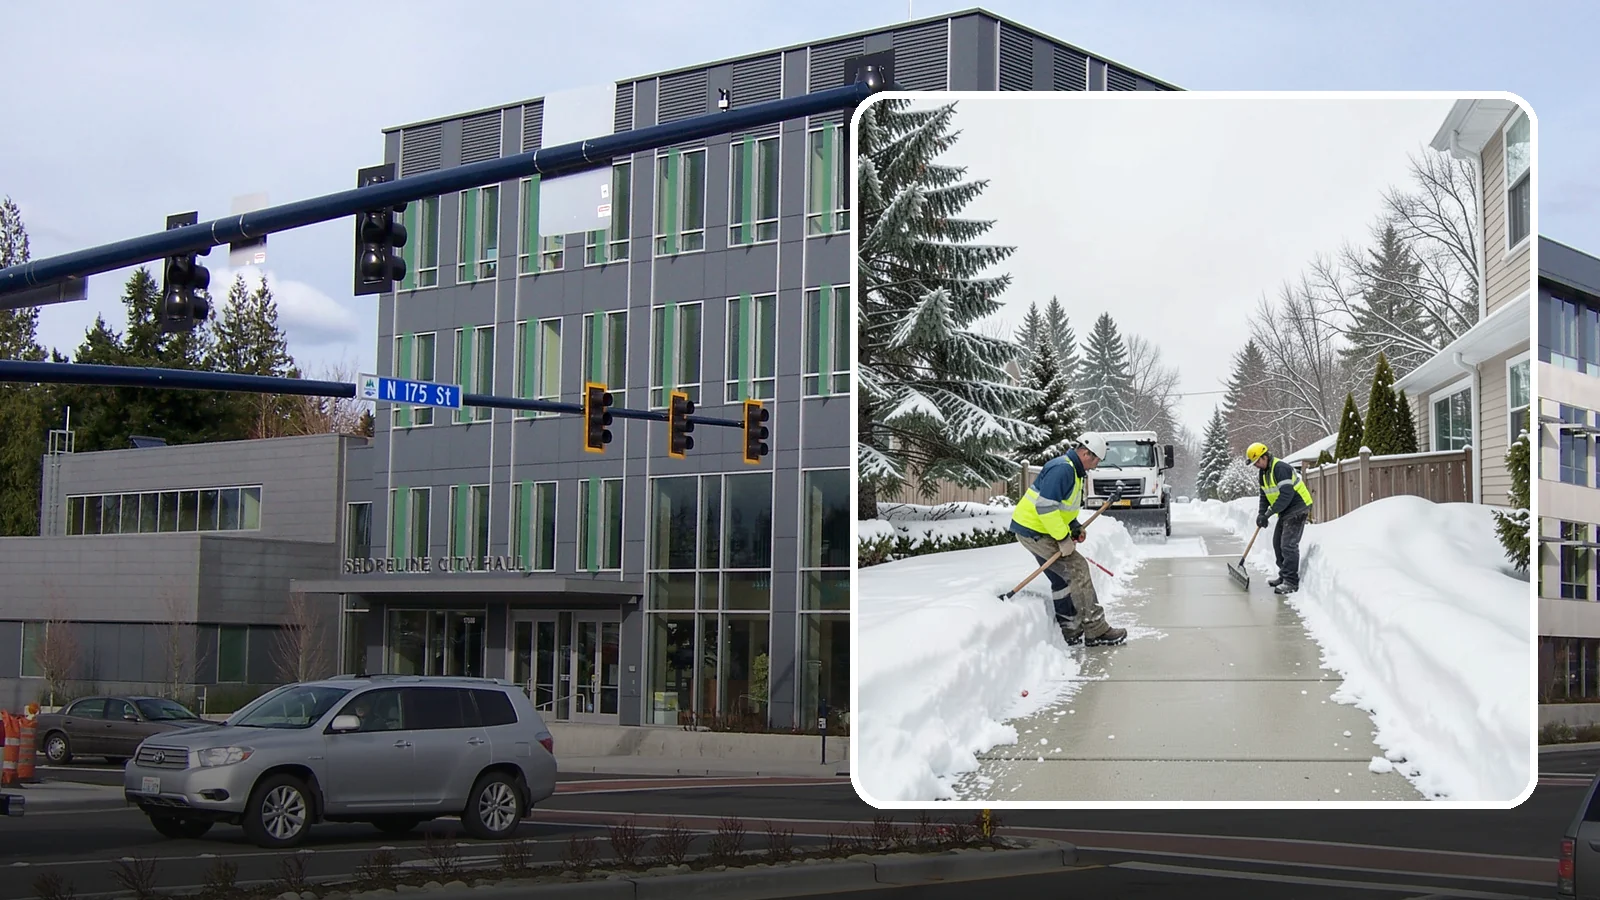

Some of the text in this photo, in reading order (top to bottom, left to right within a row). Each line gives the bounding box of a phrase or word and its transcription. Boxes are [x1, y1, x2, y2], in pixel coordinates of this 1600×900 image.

[387, 380, 451, 406] N 175 St
[343, 555, 525, 574] SHORELINE CITY HALL
